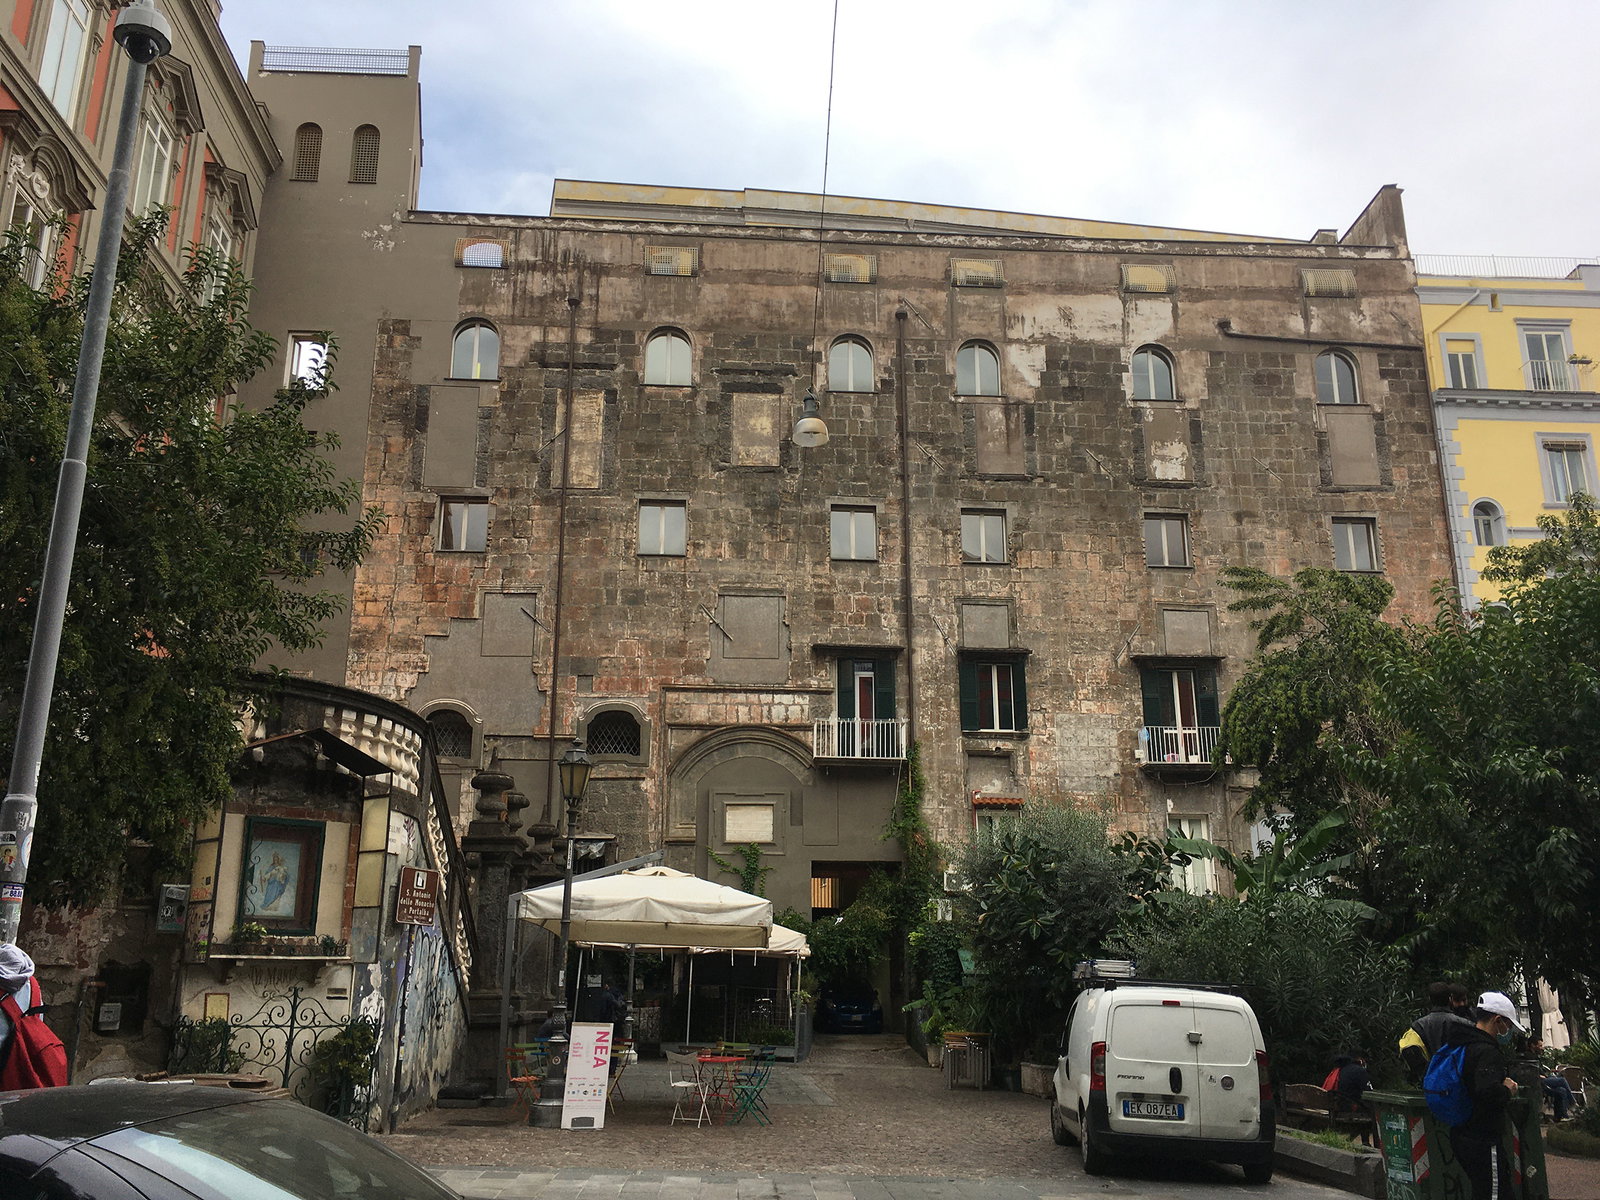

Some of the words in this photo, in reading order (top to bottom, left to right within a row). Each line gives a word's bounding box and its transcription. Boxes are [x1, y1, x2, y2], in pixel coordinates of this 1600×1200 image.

[406, 889, 411, 897] S.
[412, 890, 431, 899] Antonio
[400, 897, 413, 906] delle
[414, 899, 435, 908] Monache
[592, 1031, 610, 1068] NEA
[1130, 1102, 1142, 1114] EK
[1146, 1103, 1177, 1116] 087EA
